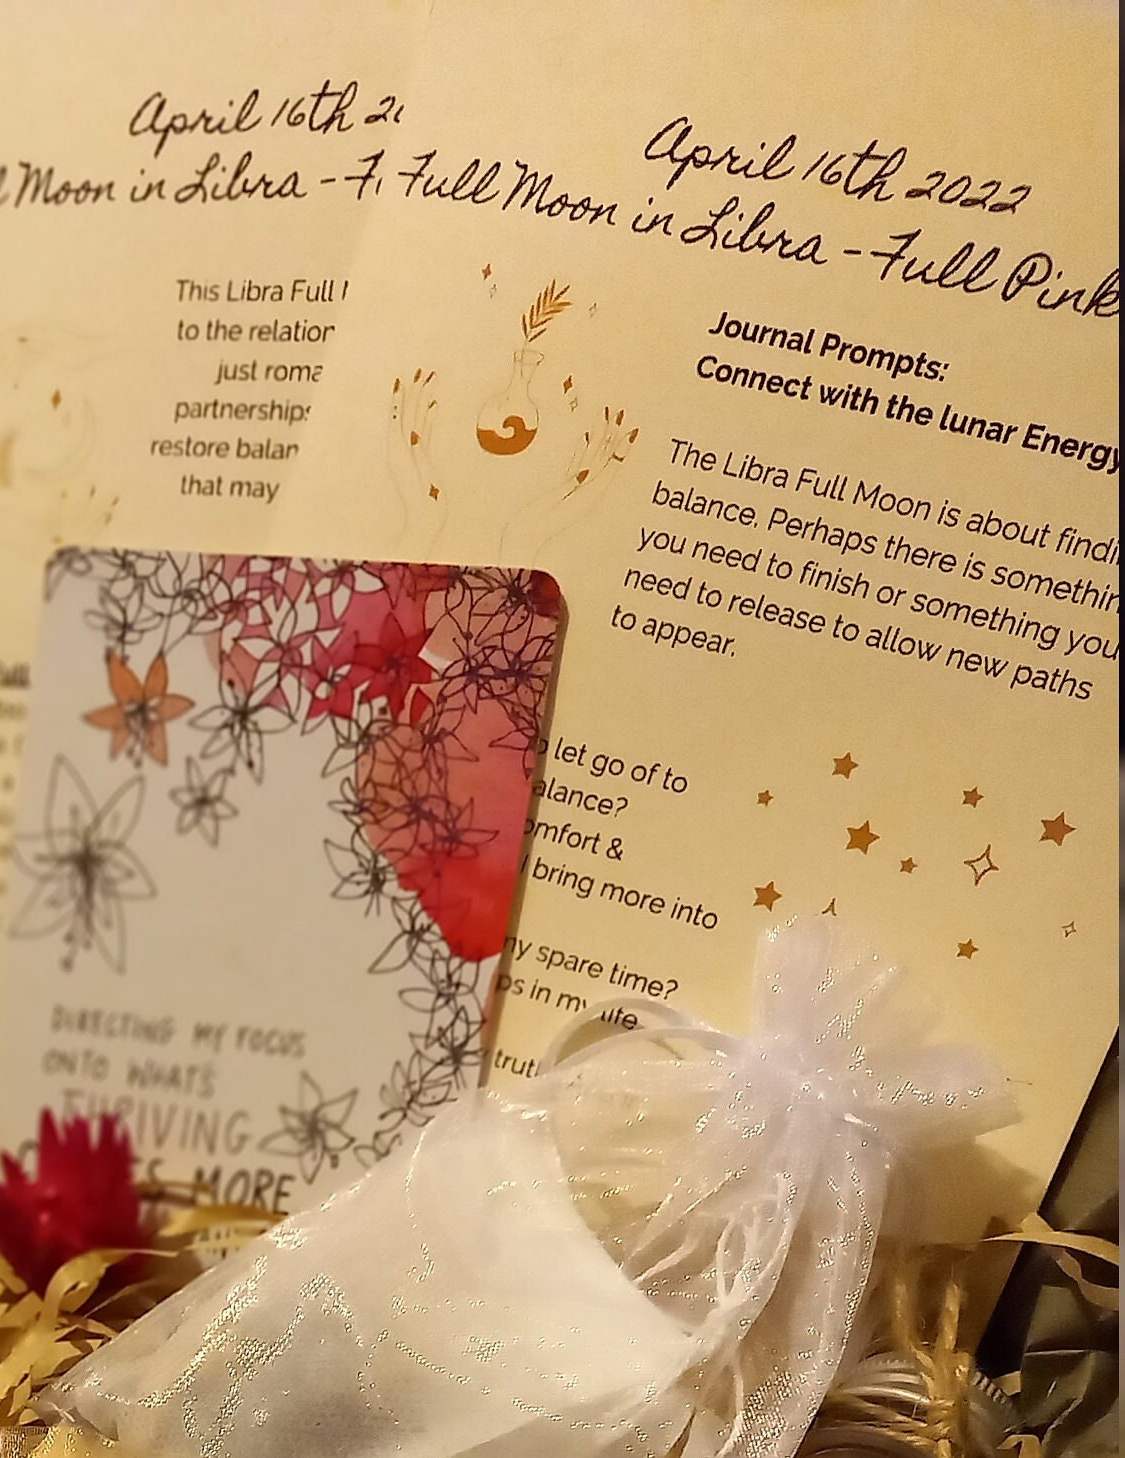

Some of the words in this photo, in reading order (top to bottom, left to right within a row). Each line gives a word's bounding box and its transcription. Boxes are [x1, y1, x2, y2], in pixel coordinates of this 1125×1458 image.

[130, 89, 263, 158] April
[271, 80, 355, 134] 16th
[15, 160, 116, 208] Moon
[130, 168, 166, 202] in
[174, 151, 307, 203] Libra
[643, 116, 797, 190] April
[801, 140, 907, 201] 16th
[905, 171, 1032, 213] 2022
[398, 149, 502, 203] Full
[502, 159, 618, 225] Moon
[631, 197, 672, 236] in
[680, 196, 827, 264] Libra
[870, 229, 1001, 293] Full
[1002, 252, 1119, 317] Pink
[176, 279, 220, 302] This
[226, 279, 283, 302] Libra
[290, 279, 335, 302] Full
[177, 320, 200, 341] to
[206, 318, 243, 341] the
[708, 311, 816, 354] Journal
[819, 332, 950, 381] Prompts:
[214, 359, 257, 384] just
[696, 355, 814, 401] Connect
[819, 384, 879, 415] with
[885, 394, 933, 425] the
[938, 404, 1018, 444] lunar
[150, 436, 230, 458] restore
[180, 474, 223, 496] that
[229, 480, 280, 504] may
[670, 438, 716, 471] The
[722, 452, 789, 488] Libra
[795, 468, 848, 501] Full
[852, 480, 931, 520] Moon
[937, 499, 961, 527] is
[966, 510, 1051, 548] about
[652, 480, 759, 528] balance.
[767, 507, 878, 555] Perhaps
[883, 534, 957, 573] there
[962, 552, 986, 580] is
[636, 527, 686, 555] you
[691, 540, 763, 572] need
[767, 552, 793, 580] to
[799, 560, 870, 599] finish
[876, 584, 907, 607] or
[910, 592, 1061, 650] something
[1064, 629, 1119, 661] you
[611, 605, 637, 631] to
[642, 617, 735, 657] appear.
[624, 568, 692, 600] need
[697, 581, 722, 608] to
[728, 594, 826, 633] release
[832, 614, 860, 642] to
[865, 625, 942, 662] allow
[945, 647, 1008, 678] new
[1010, 664, 1094, 700] paths
[554, 737, 587, 766] let
[590, 753, 624, 777] go
[631, 763, 661, 786] of
[663, 767, 688, 793] to
[606, 838, 624, 861] &
[532, 857, 595, 899] bring
[600, 880, 665, 915] more
[670, 896, 718, 929] into
[530, 979, 551, 1004] in
[536, 944, 603, 979] spare
[609, 962, 679, 1001] time?
[50, 1004, 175, 1045] DIRECTING
[192, 1020, 228, 1053] MY
[236, 1025, 307, 1059] FOCUS
[40, 1048, 111, 1082] ONTO
[193, 1164, 296, 1216] MORE
